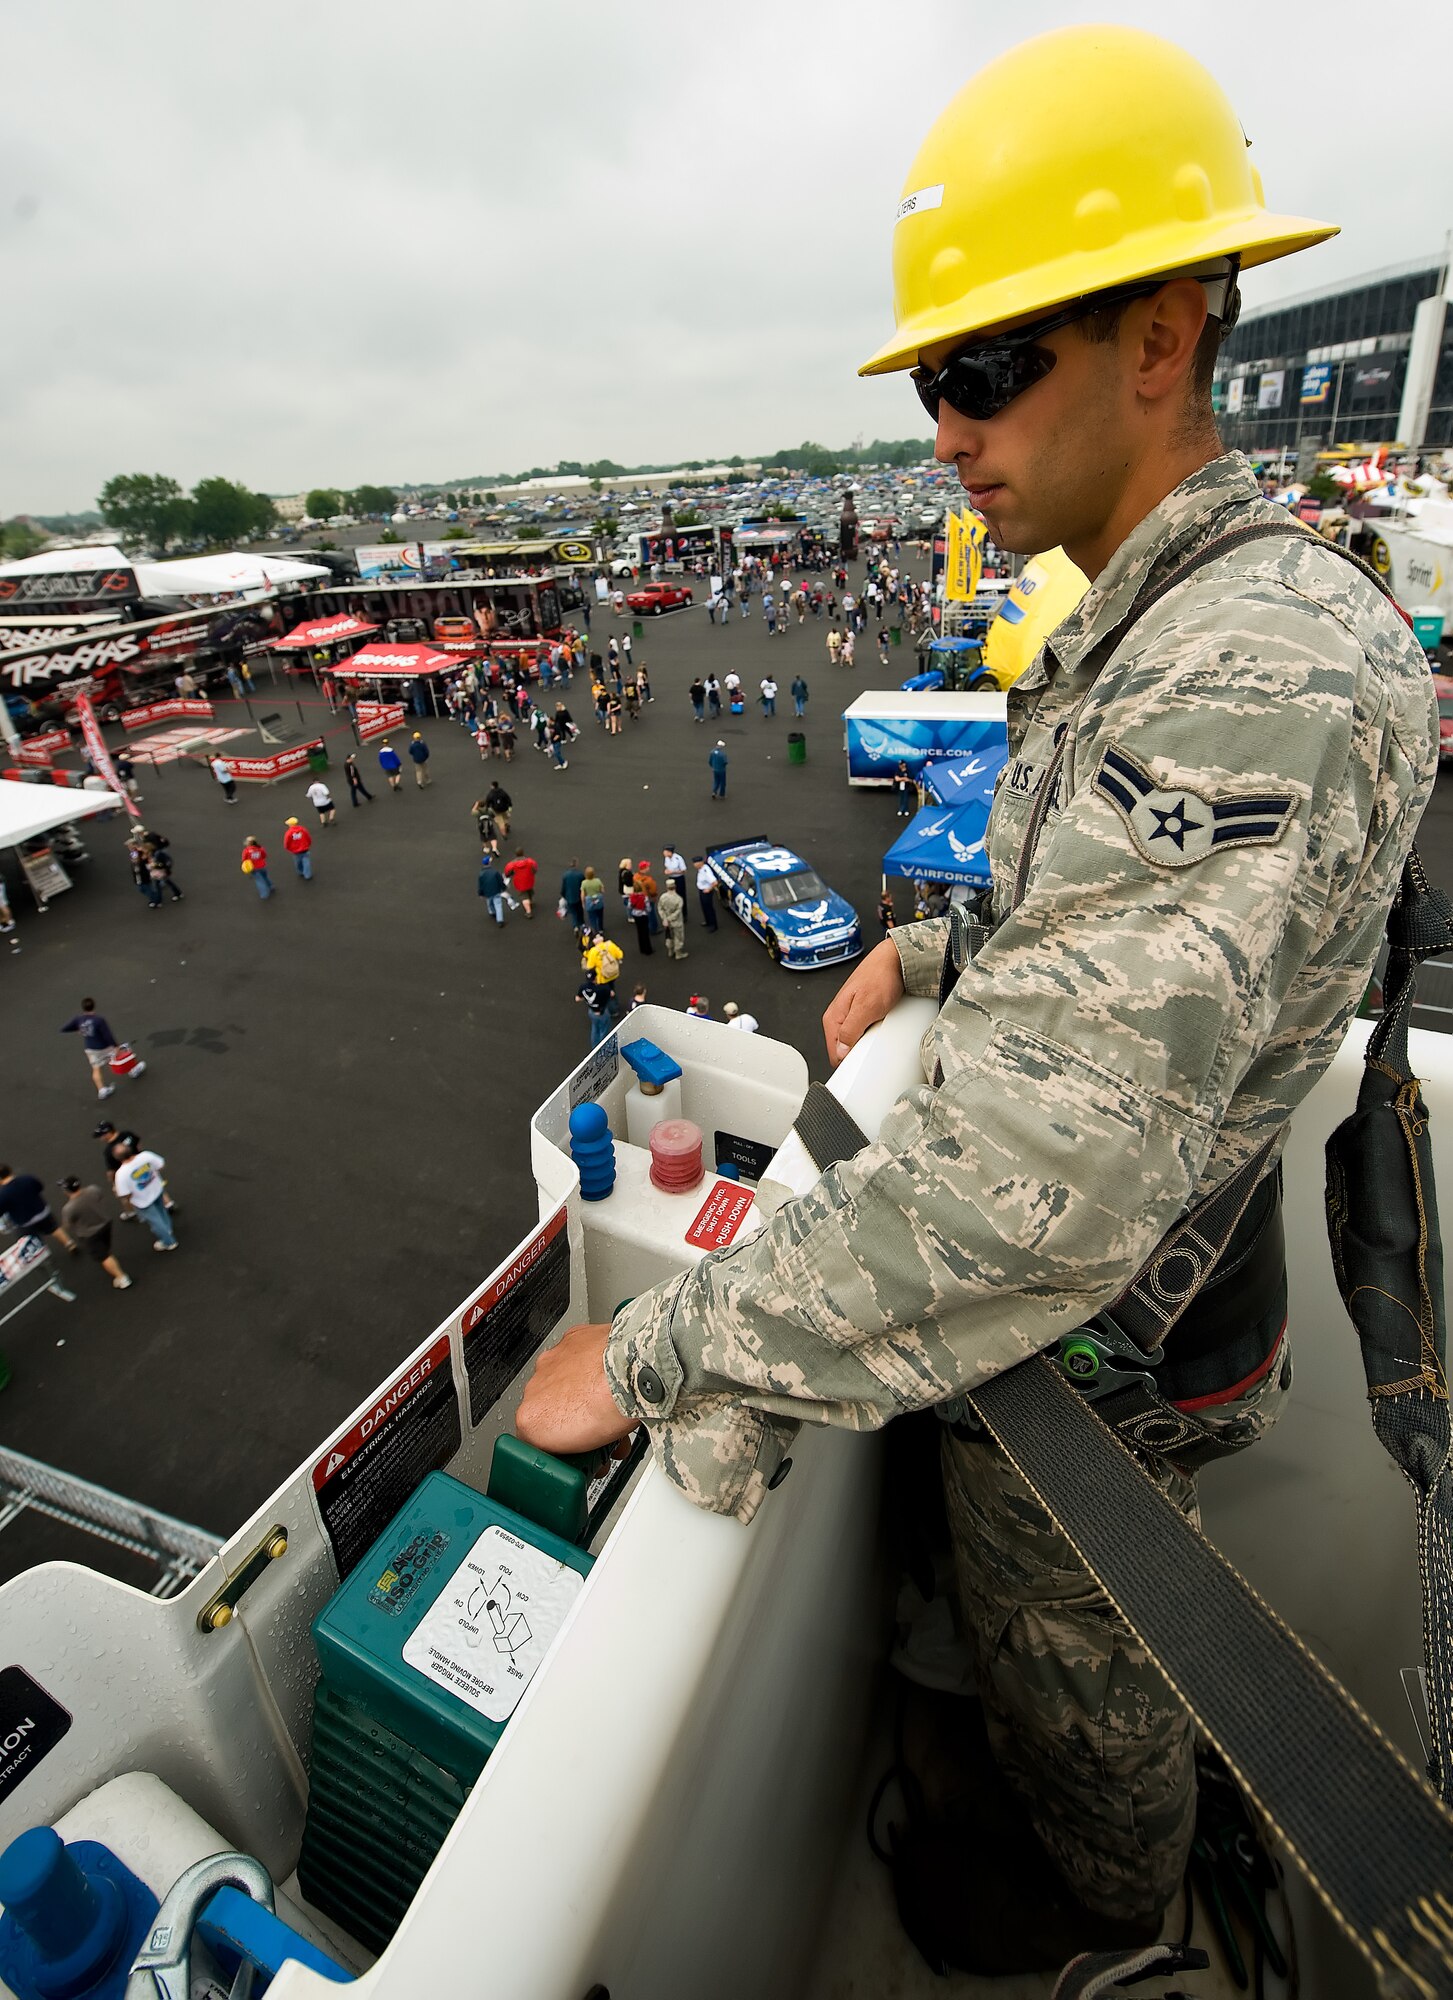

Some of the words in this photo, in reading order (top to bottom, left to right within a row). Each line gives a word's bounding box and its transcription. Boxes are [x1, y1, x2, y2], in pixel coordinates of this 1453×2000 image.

[1407, 559, 1433, 587] Sprint
[22, 575, 96, 596] CHEVROLET
[1, 633, 140, 687] TRAXXAS
[887, 747, 973, 757] AIRFORCE.COM
[1011, 762, 1033, 792] U.S.
[747, 850, 798, 871] 43
[822, 915, 845, 927] FORCE
[732, 1152, 757, 1166] TOOLS
[693, 1200, 718, 1238] EMERGENCY
[714, 1188, 727, 1203] HYD.
[705, 1215, 718, 1233] SHUT
[716, 1197, 730, 1216] DOWN
[716, 1221, 734, 1244] PUSH
[728, 1197, 748, 1221] DOWN
[496, 1235, 546, 1297] DANGER
[360, 1358, 432, 1438] DANGER
[341, 1422, 395, 1480] ELECTRICAL
[395, 1379, 434, 1422] HAZARDS
[326, 1490, 348, 1515] DEATH
[354, 1453, 381, 1483] SERIOUS
[381, 1431, 401, 1454] INJURY
[332, 1500, 352, 1529] NEVER
[352, 1489, 362, 1505] rely
[382, 1442, 404, 1470] electrical
[385, 1535, 443, 1606] ISO-Grip
[467, 1561, 486, 1576] LOWER
[498, 1564, 513, 1577] FOLD
[405, 1576, 422, 1599] PATENT
[516, 1591, 530, 1602] CCW
[453, 1598, 464, 1608] CW
[458, 1618, 480, 1635] UNFOLD
[427, 1647, 451, 1665] HANDLE
[430, 1661, 455, 1680] TRIGGER
[449, 1661, 472, 1679] MOVING
[506, 1665, 524, 1680] RAISE
[453, 1676, 481, 1698] SQUEEZE
[470, 1675, 494, 1694] BEFORE
[0, 1717, 36, 1762] ION
